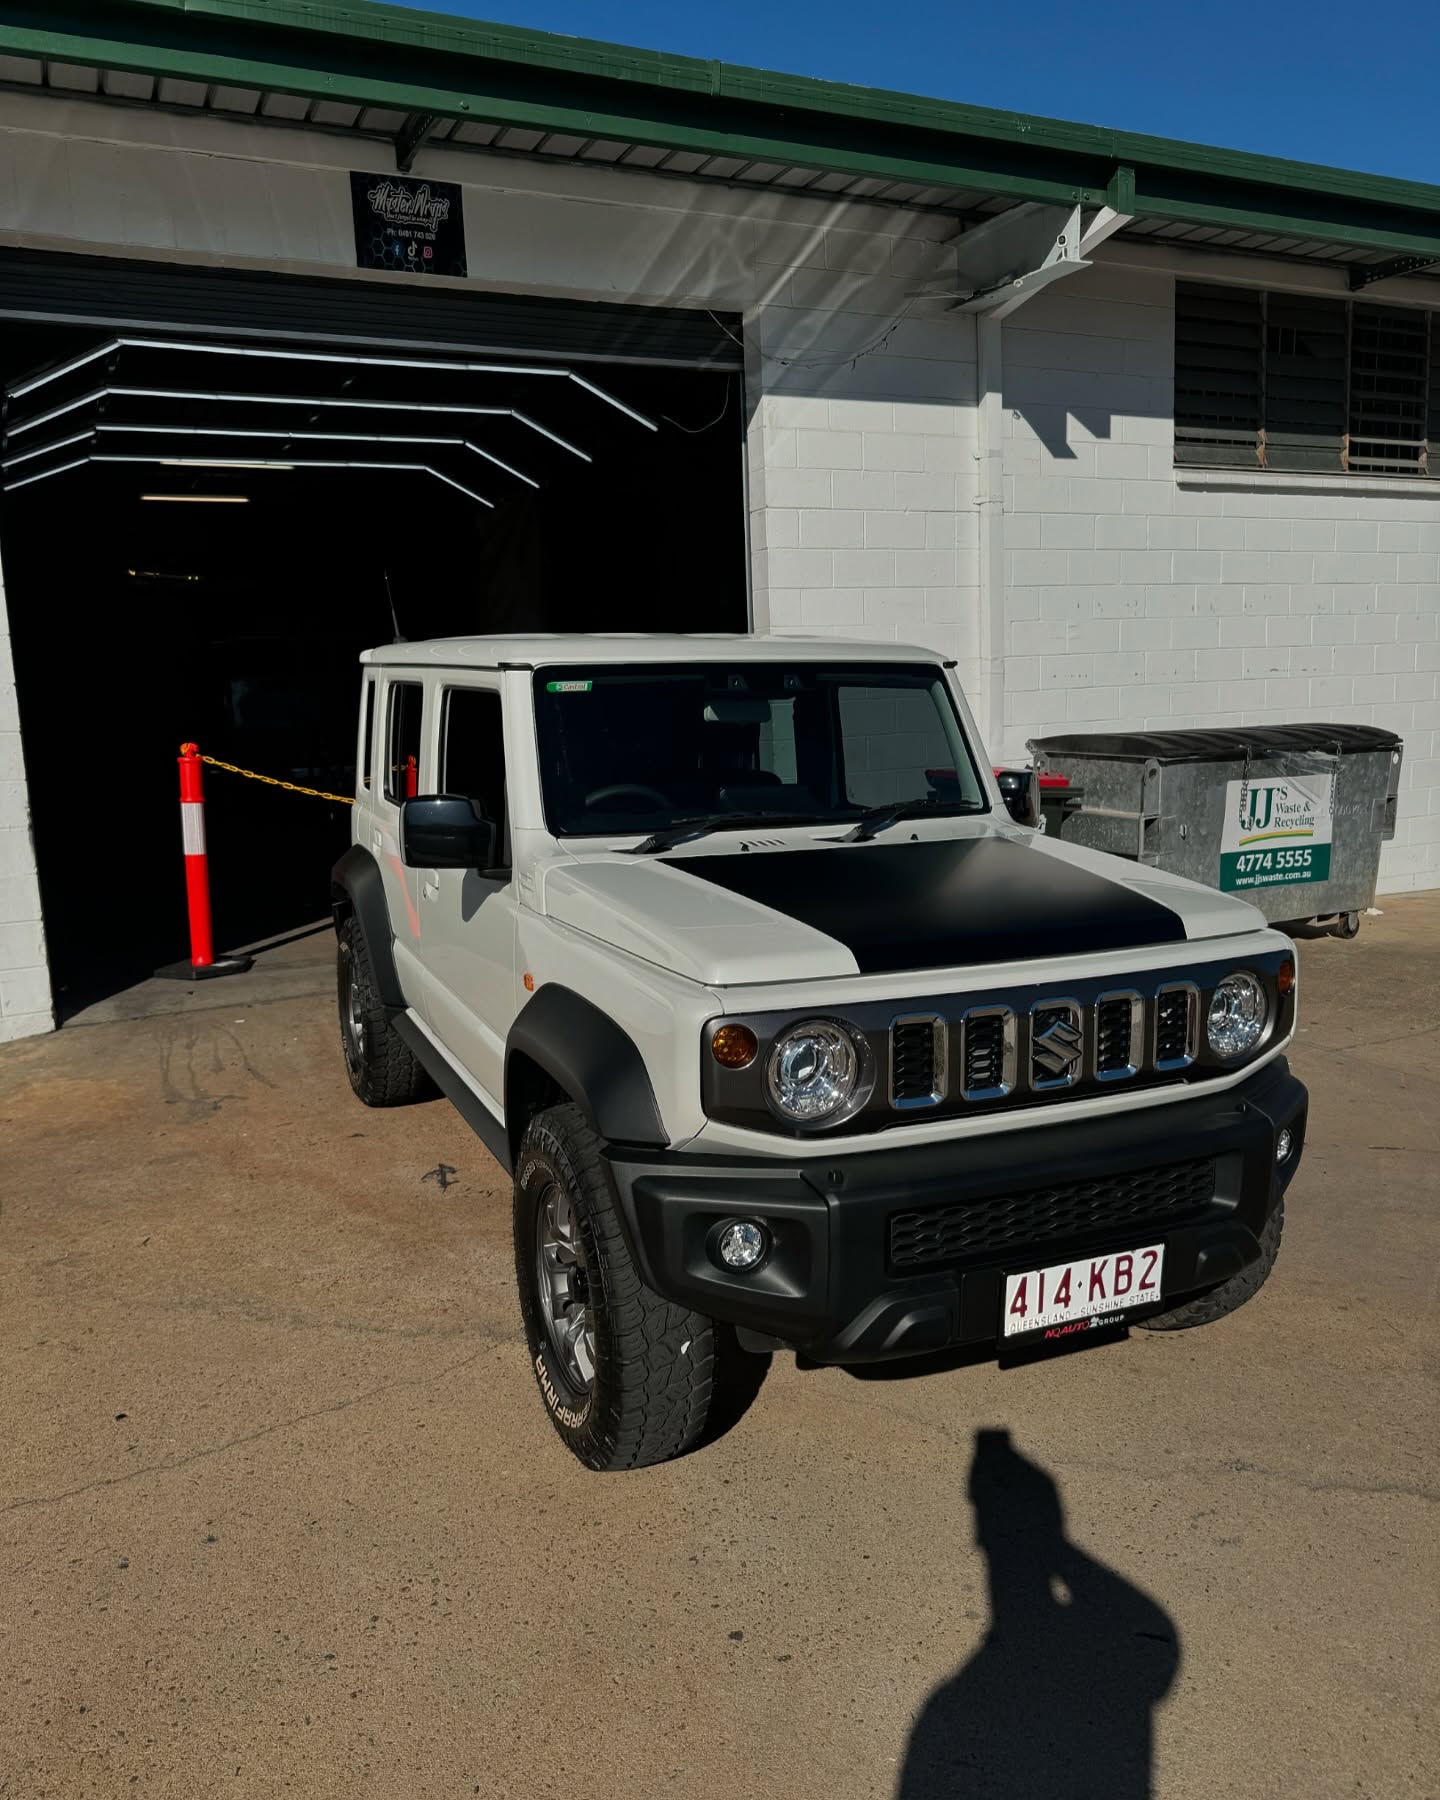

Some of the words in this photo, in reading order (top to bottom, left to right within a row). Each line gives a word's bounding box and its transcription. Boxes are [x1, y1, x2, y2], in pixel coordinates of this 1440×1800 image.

[1275, 802, 1301, 814] Waste
[1303, 801, 1311, 812] &
[1274, 815, 1315, 829] Recycling
[1236, 852, 1273, 873] 4774
[1275, 849, 1312, 869] 5555
[1235, 871, 1312, 886] www.jjswaste.com.au
[1009, 1311, 1071, 1334] QUEENSLAND
[1080, 1299, 1125, 1316] SUNSHINE
[1129, 1291, 1155, 1305] STATE
[1099, 1314, 1125, 1326] GROUP
